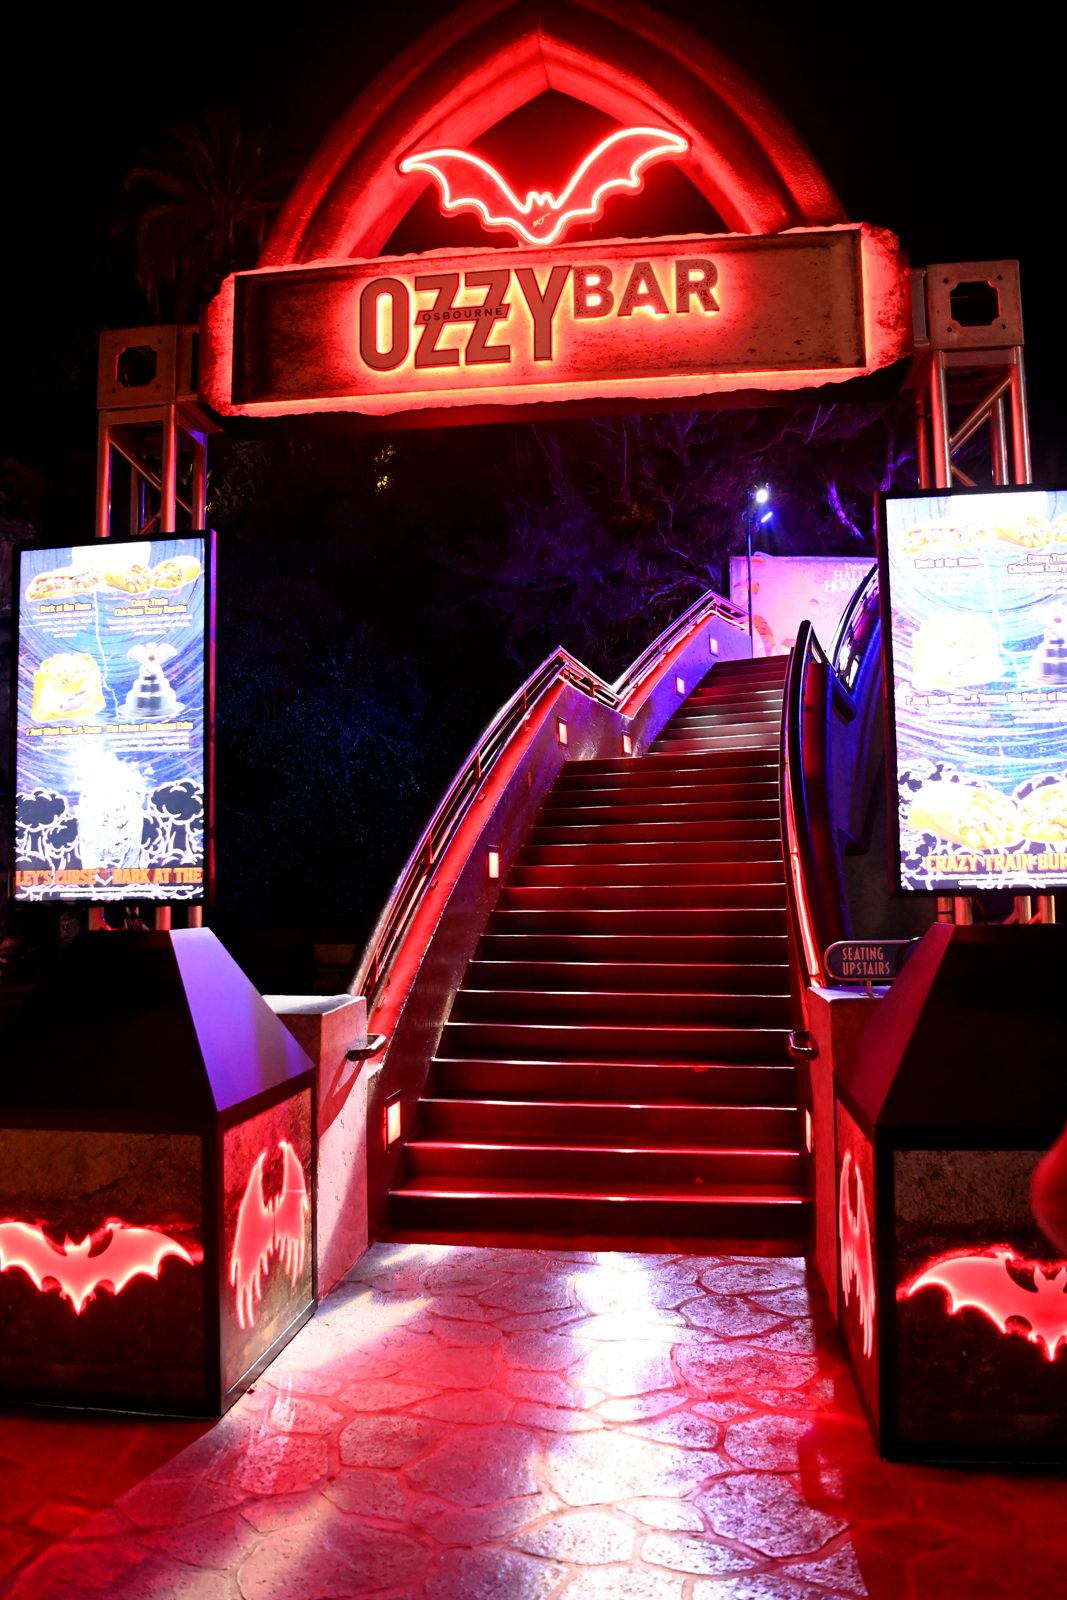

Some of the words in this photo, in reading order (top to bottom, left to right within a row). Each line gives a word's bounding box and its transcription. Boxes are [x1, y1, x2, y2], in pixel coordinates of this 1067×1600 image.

[573, 258, 720, 320] BAR
[422, 307, 504, 322] OSBOURNE
[926, 855, 977, 872] CRAZY
[983, 854, 1034, 872] TRAIN
[112, 868, 150, 884] BARK
[153, 868, 172, 884] AT
[175, 867, 203, 883] THE
[842, 947, 883, 960] SEATING
[842, 961, 890, 976] UPSTAIRS
